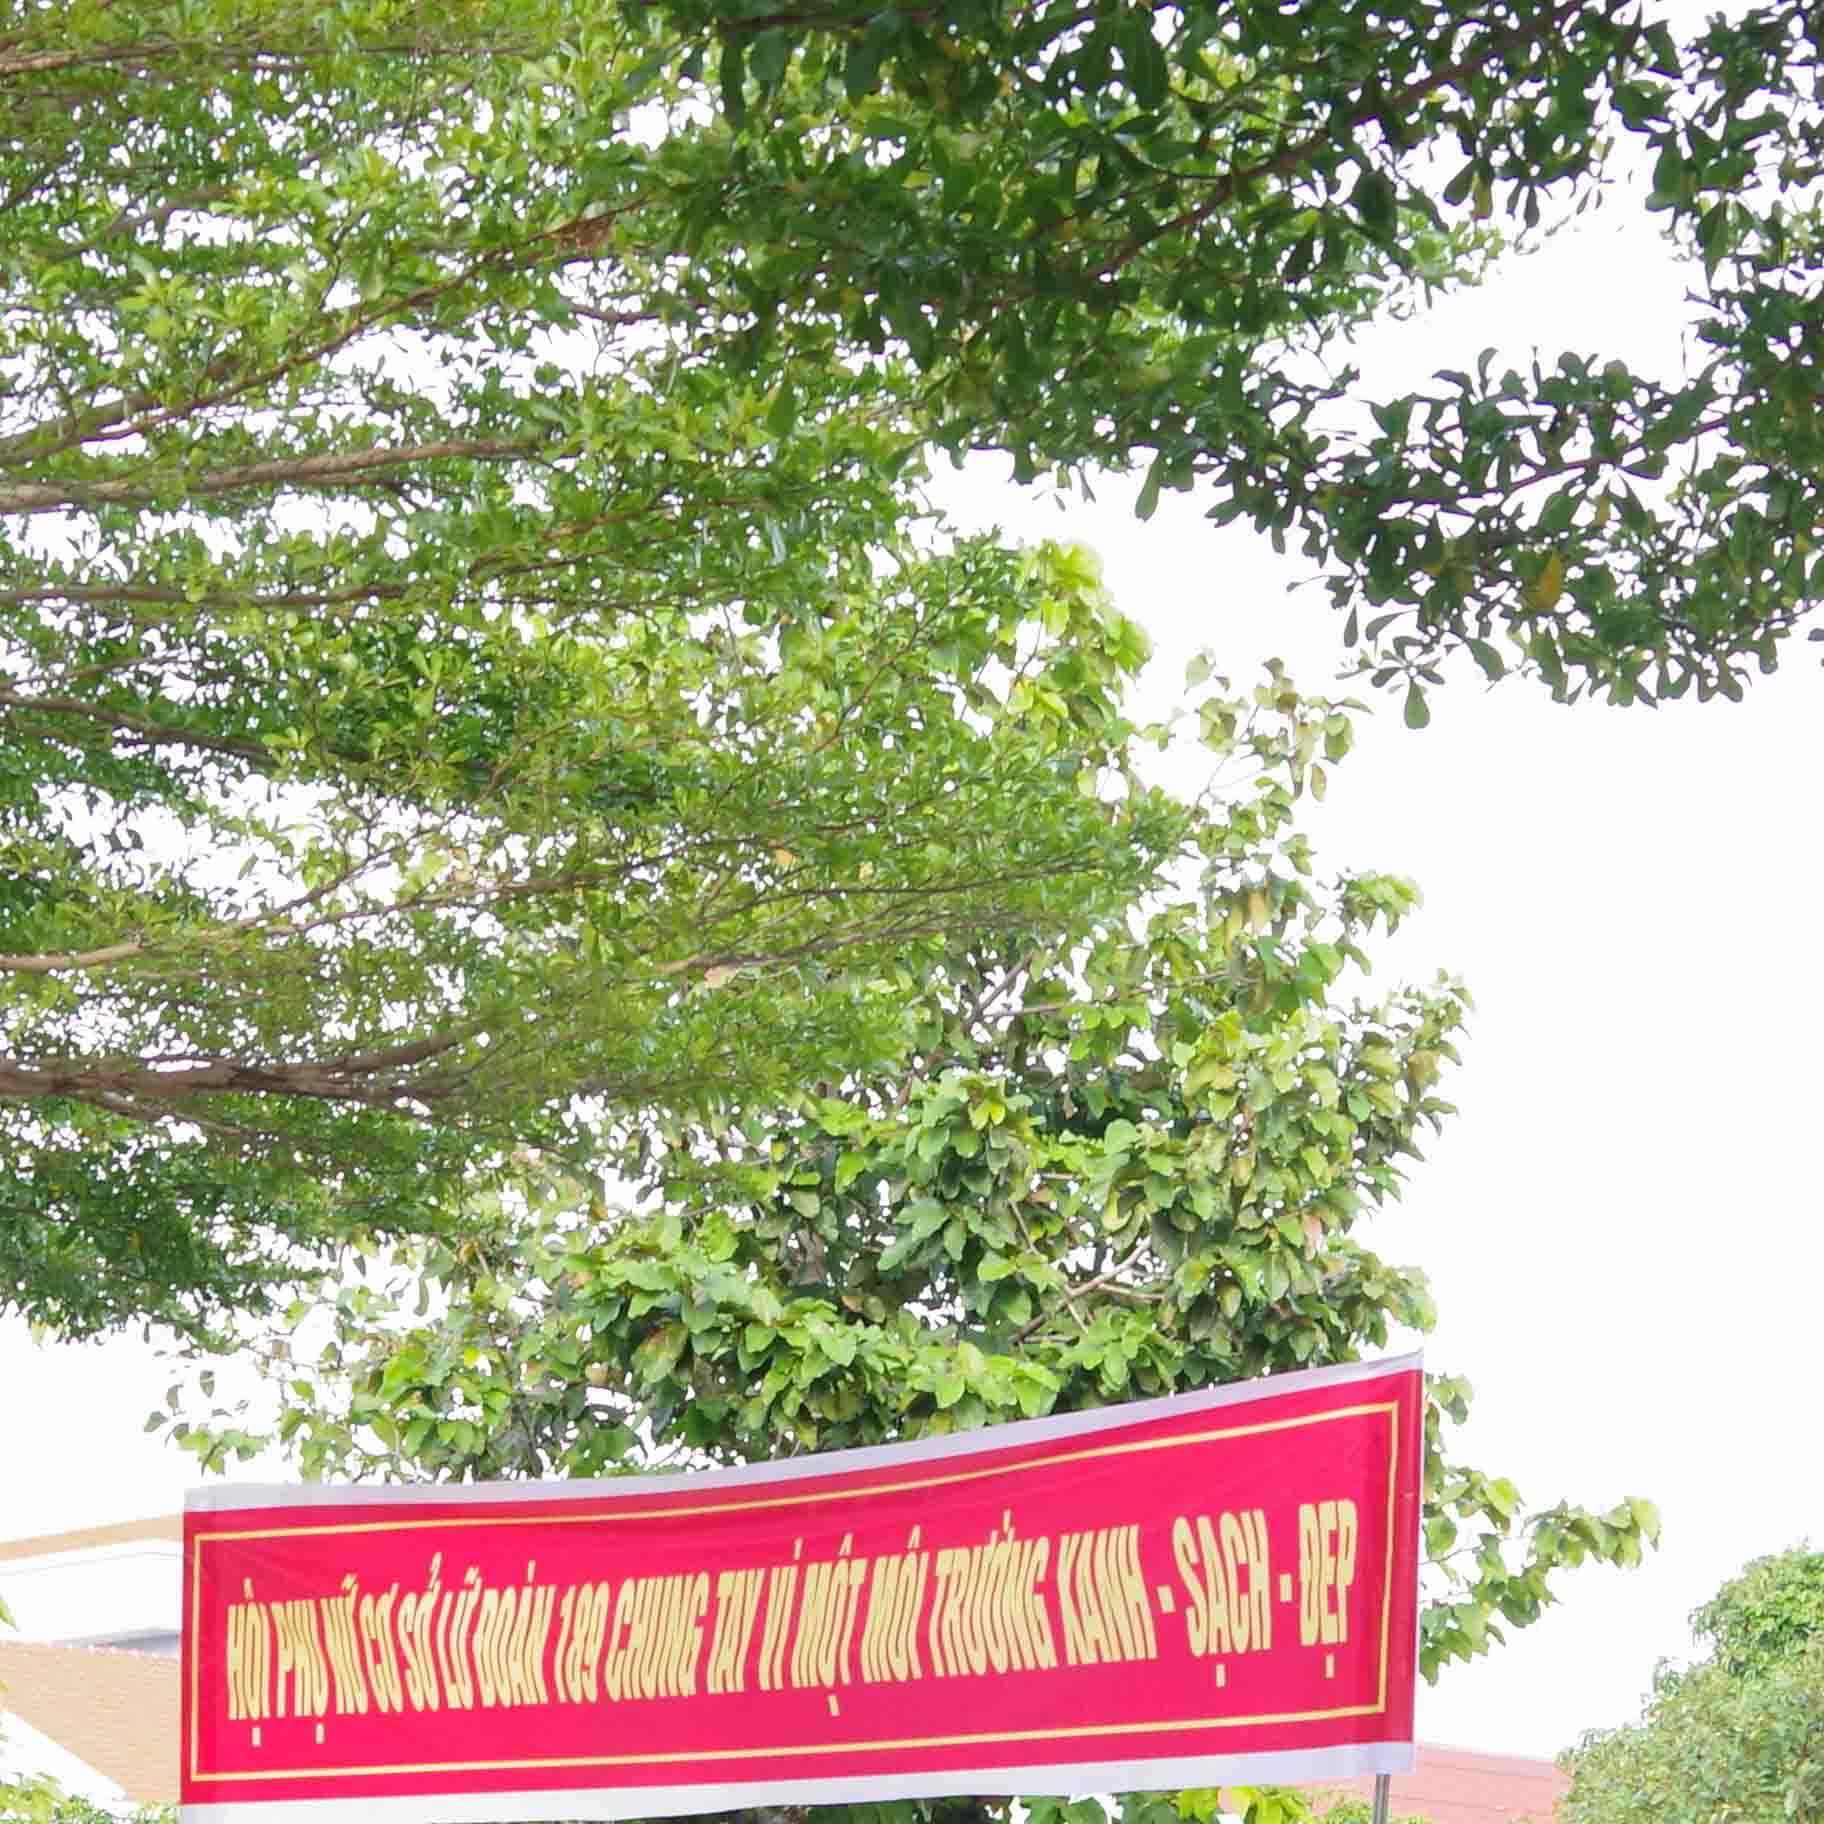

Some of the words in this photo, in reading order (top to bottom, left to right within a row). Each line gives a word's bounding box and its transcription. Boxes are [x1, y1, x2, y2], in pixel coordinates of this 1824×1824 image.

[227, 1576, 271, 1747] HỘI
[270, 1599, 329, 1745] PHỤ
[320, 1573, 368, 1715] NỮ
[360, 1582, 404, 1713] CƠ
[398, 1552, 442, 1712] SỞ
[436, 1566, 482, 1710] LỮ
[473, 1559, 556, 1709] ĐOÀN
[554, 1581, 610, 1703] 189
[605, 1571, 710, 1701] CHUNG
[706, 1567, 766, 1694] TAY
[759, 1537, 803, 1691] VÌ
[791, 1532, 868, 1717] MỘT
[860, 1524, 930, 1684] MÔI
[929, 1509, 1058, 1677] TRƯỜNG
[1057, 1524, 1158, 1665] XANH
[1157, 1584, 1176, 1613] -
[1172, 1508, 1273, 1688] SẠCH
[1279, 1572, 1293, 1603] -
[1298, 1498, 1358, 1679] ĐẸP
